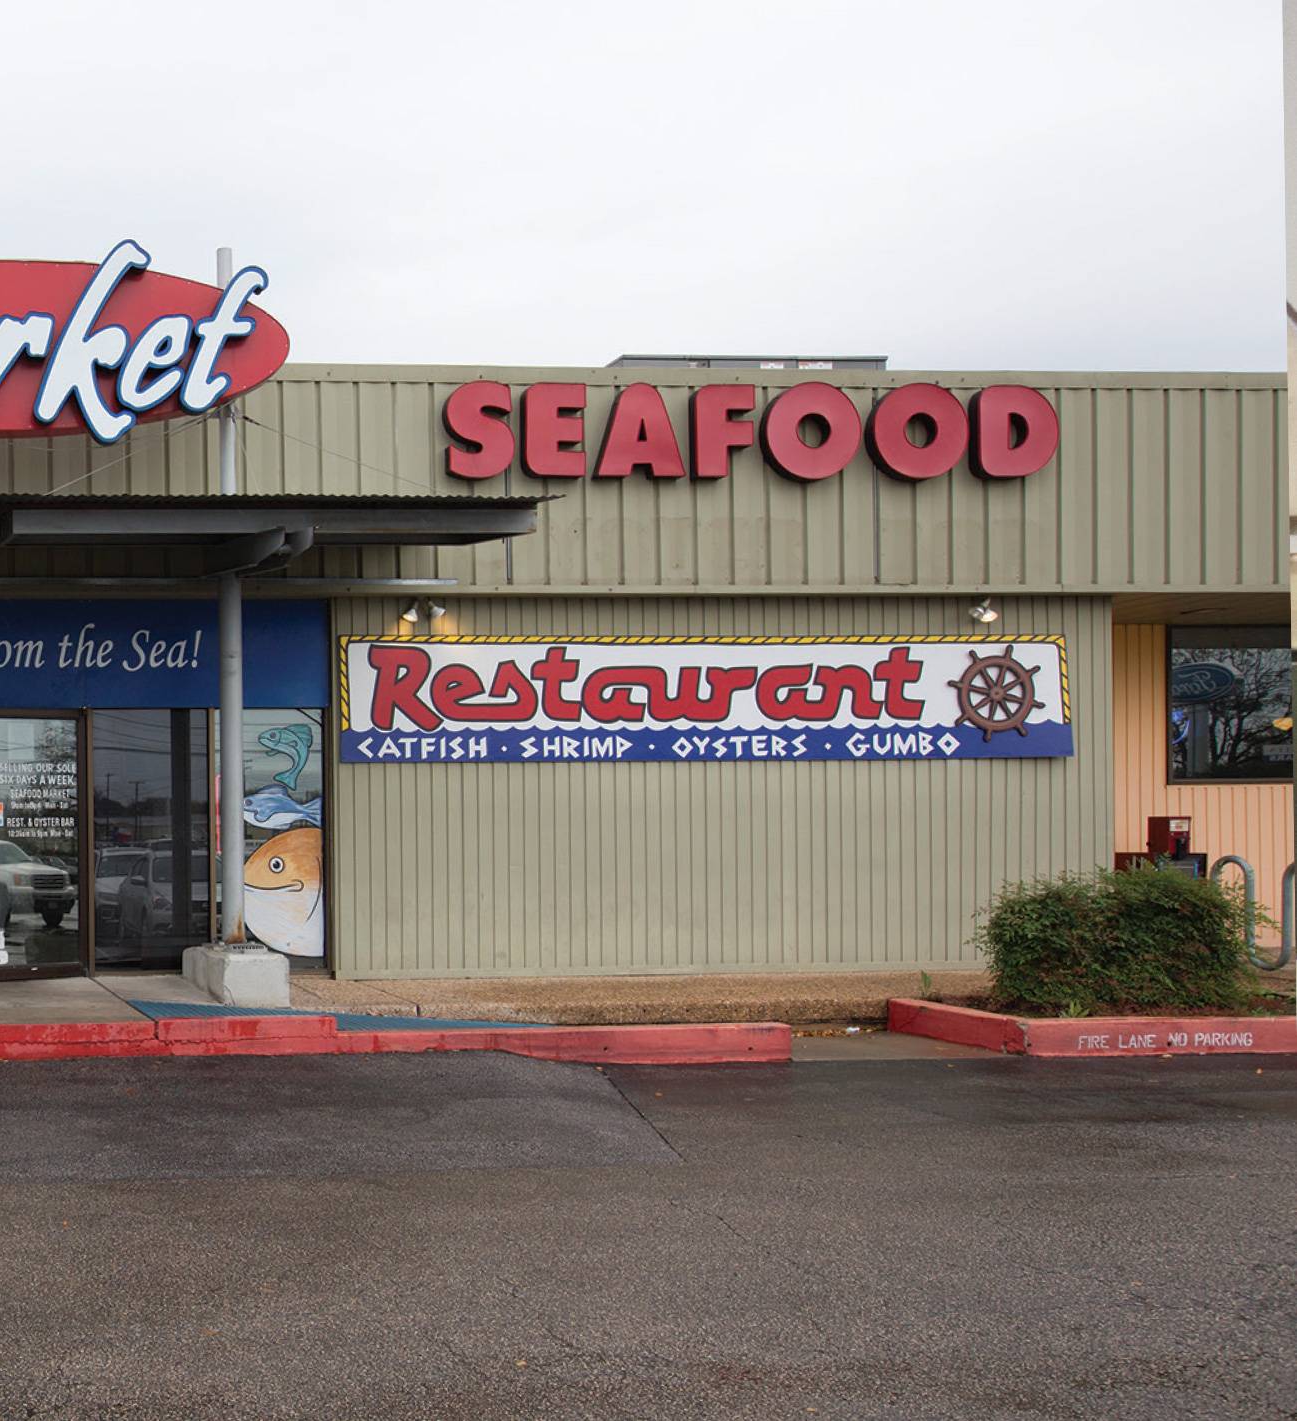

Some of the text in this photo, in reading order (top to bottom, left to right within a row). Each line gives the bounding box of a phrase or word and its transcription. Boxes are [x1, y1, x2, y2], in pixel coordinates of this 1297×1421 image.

[443, 381, 1059, 482] SEAFOOD
[57, 623, 112, 668] the
[122, 629, 203, 671] Sea!
[367, 644, 925, 732] Restaurant
[357, 732, 960, 760] CATFISH SHRIMP OYSTERS GUMBO
[0, 763, 77, 774] SELLING OUR SOLE
[0, 774, 14, 785] SIX
[16, 774, 37, 785] DAYS
[39, 774, 46, 785] A
[10, 789, 42, 799] SEAFOOD
[7, 817, 74, 828] REST. & OYSTER BAR
[1078, 1032, 1253, 1049] FIRE LANE NO PARKING
